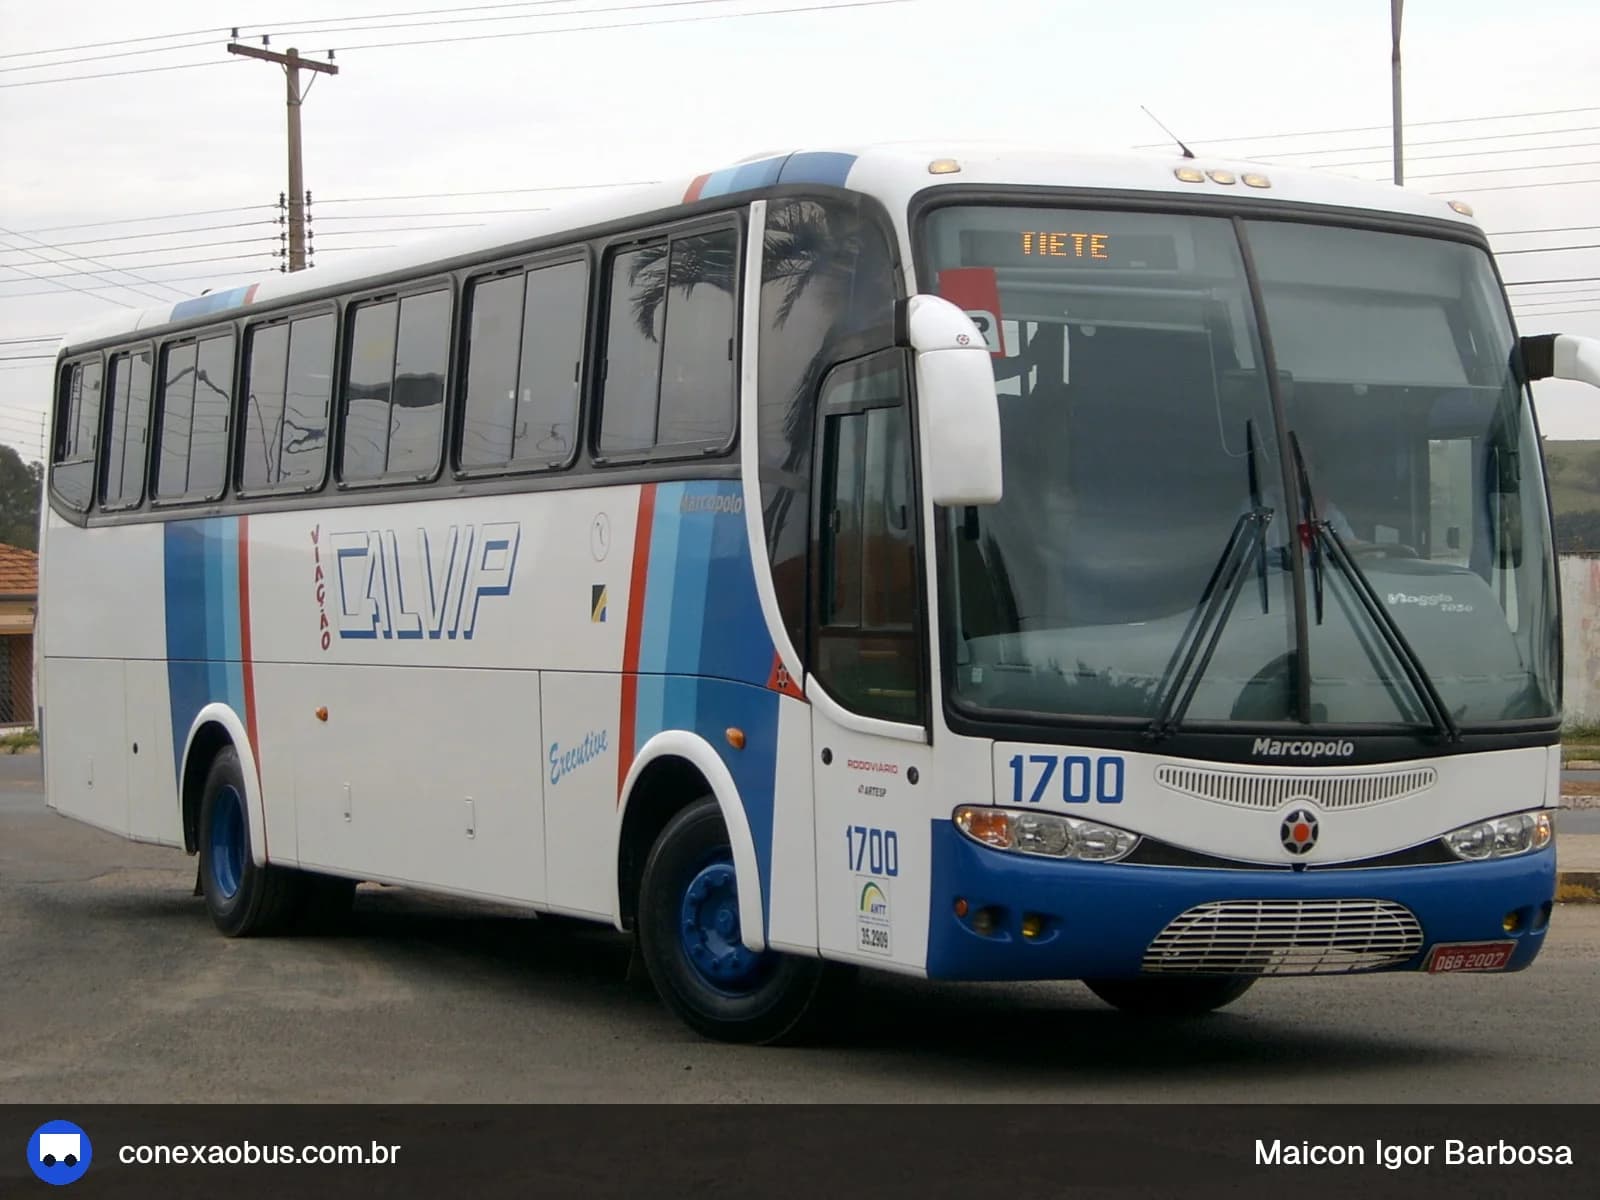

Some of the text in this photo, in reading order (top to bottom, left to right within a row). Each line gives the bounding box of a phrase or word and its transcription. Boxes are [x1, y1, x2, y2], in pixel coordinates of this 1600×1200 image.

[1021, 231, 1109, 259] TIETE
[329, 521, 521, 640] CALVIP
[549, 729, 609, 785] Executive
[1252, 737, 1355, 758] Marcopolo
[1009, 754, 1125, 805] 1700
[846, 824, 898, 877] 1700
